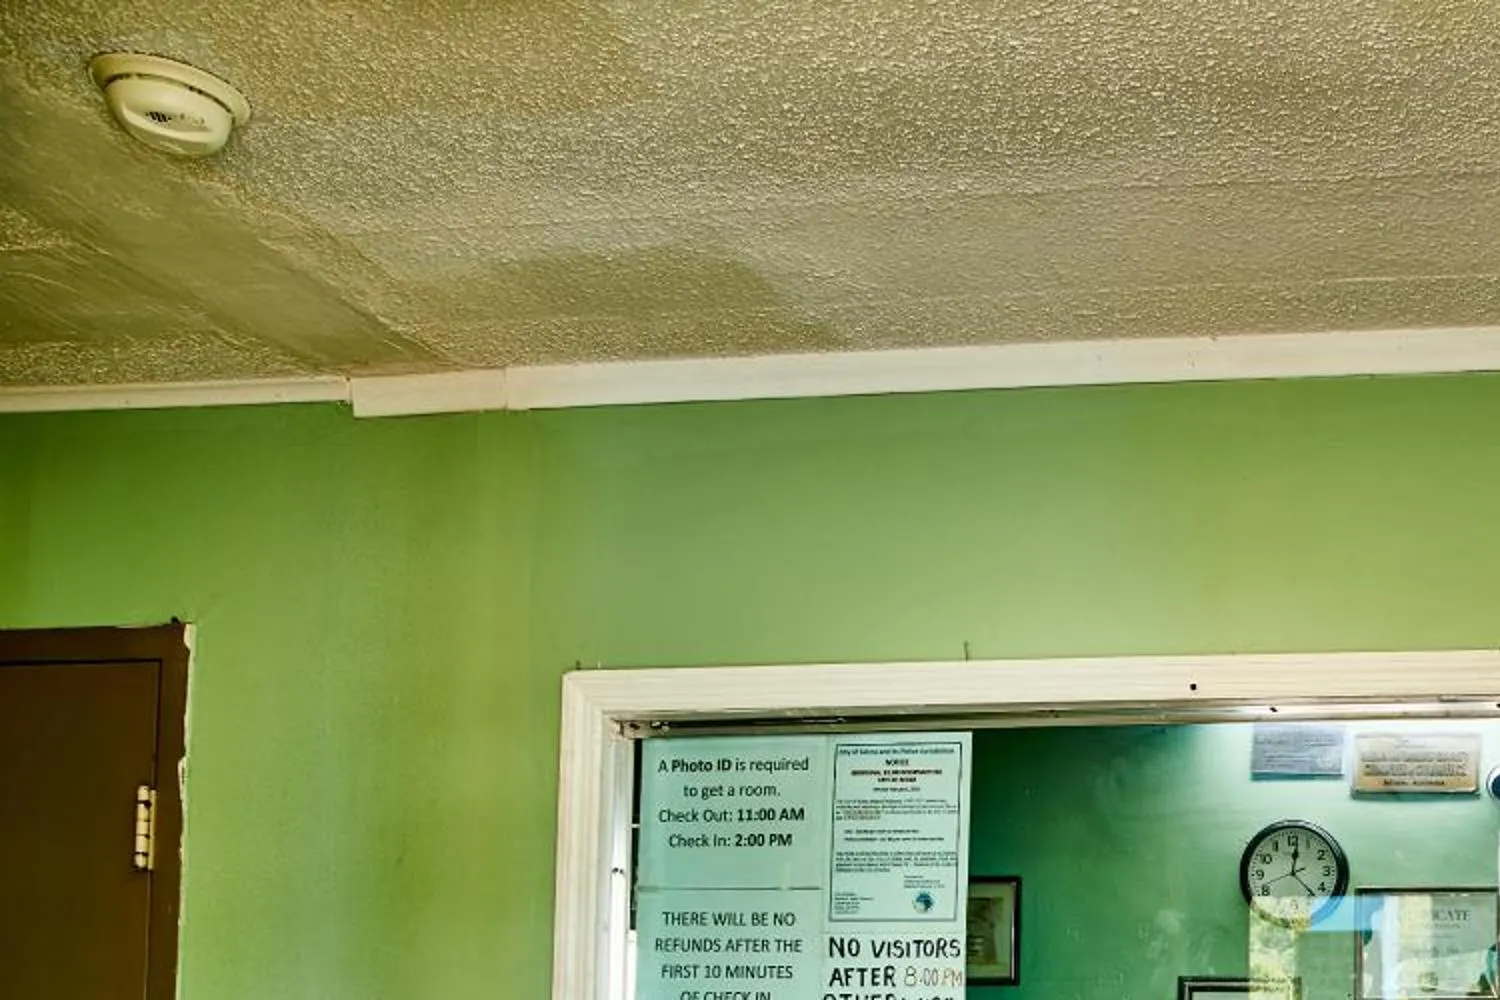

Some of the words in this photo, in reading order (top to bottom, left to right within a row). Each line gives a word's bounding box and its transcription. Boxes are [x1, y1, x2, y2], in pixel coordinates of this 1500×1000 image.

[658, 759, 669, 773] A
[671, 758, 713, 773] Photo
[717, 759, 732, 772] ID
[735, 758, 746, 772] is
[749, 756, 809, 774] required
[683, 785, 698, 797] to
[701, 785, 723, 801] get
[727, 786, 735, 797] a
[739, 785, 781, 797] room.
[658, 808, 699, 823] Check
[703, 809, 733, 823] Out:
[737, 808, 776, 821] 11:00
[779, 807, 805, 821] AM
[669, 834, 709, 848] Check
[713, 834, 731, 847] In:
[735, 834, 765, 847] 2:00
[769, 833, 793, 847] PM
[1316, 849, 1327, 861] 2
[1255, 869, 1264, 880] 9
[1322, 865, 1331, 877] 3
[1317, 881, 1327, 893] 4
[662, 911, 708, 926] THERE
[712, 912, 747, 926] WILL
[751, 912, 769, 926] BE
[773, 912, 796, 926] NO
[655, 938, 722, 952] REFUNDS
[725, 938, 770, 952] AFTER
[774, 939, 803, 953] THE
[829, 936, 860, 958] NO
[871, 937, 961, 958] VISITORS
[661, 965, 700, 979] FIRST
[704, 965, 722, 979] 10
[725, 965, 793, 979] MINUTES
[829, 965, 896, 987] AFTER
